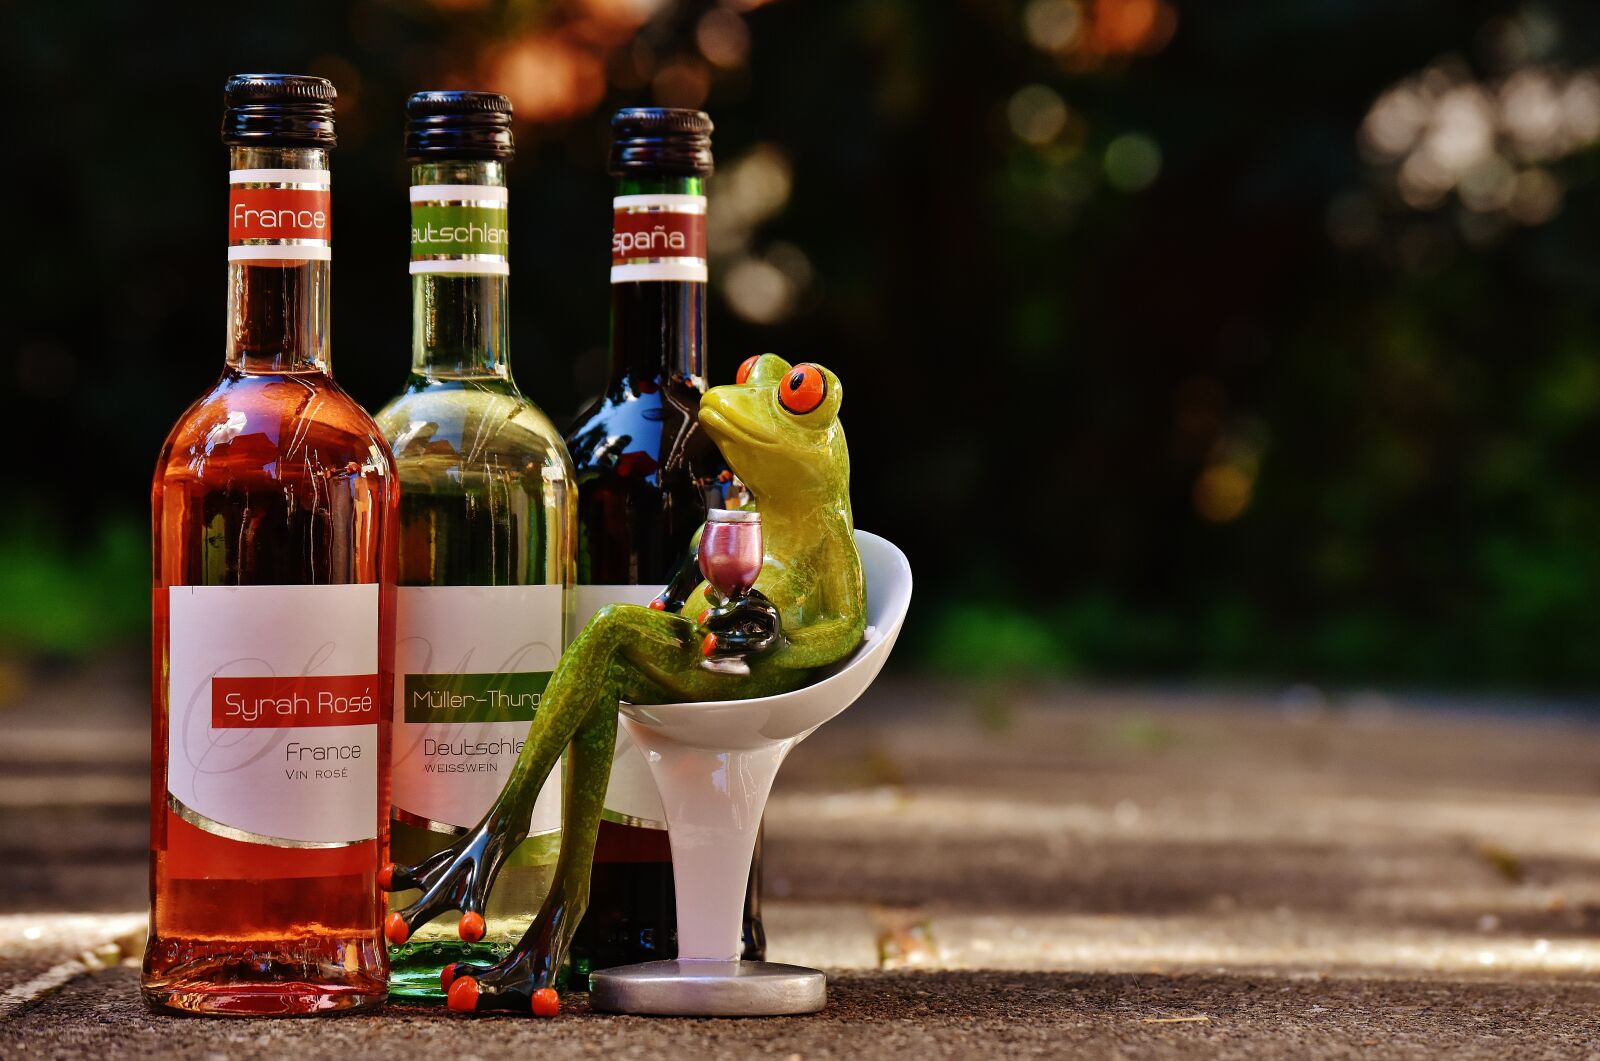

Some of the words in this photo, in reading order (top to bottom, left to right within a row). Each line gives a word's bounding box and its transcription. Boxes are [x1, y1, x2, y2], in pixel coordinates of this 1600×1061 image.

[233, 203, 326, 229] France
[411, 221, 508, 244] eutschlan
[612, 224, 685, 256] spaña
[225, 692, 310, 721] Syrah
[318, 687, 372, 714] Rosé
[413, 689, 544, 710] Müller-Thurg
[286, 742, 361, 762] France
[424, 763, 498, 773] WEISSWEIN
